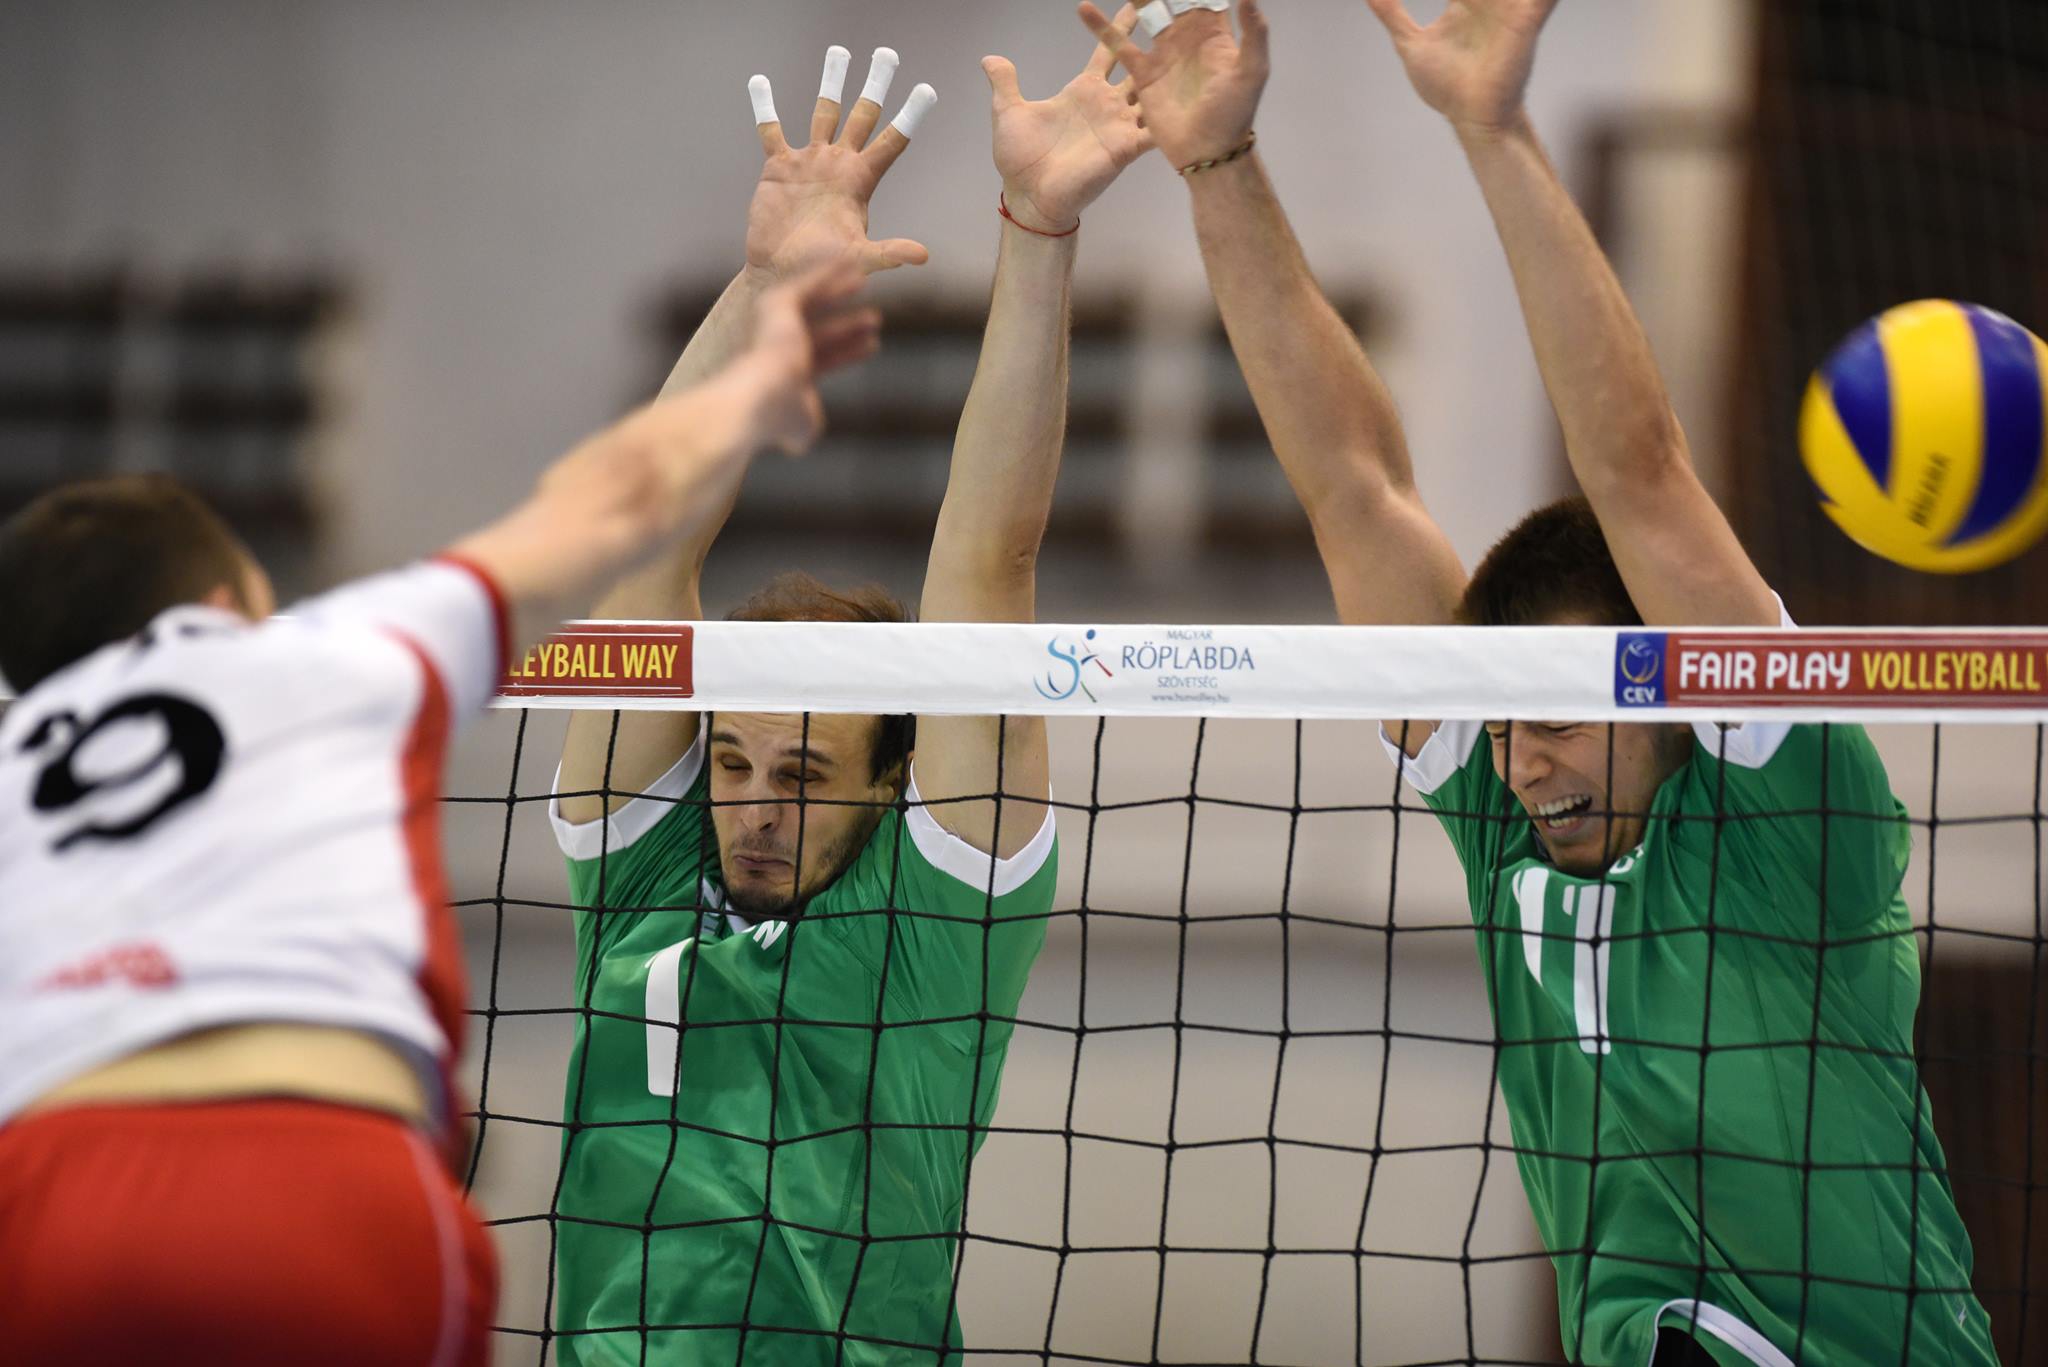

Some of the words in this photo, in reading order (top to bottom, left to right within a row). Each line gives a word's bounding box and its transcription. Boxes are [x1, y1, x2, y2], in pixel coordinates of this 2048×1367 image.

[1166, 630, 1213, 640] MAGYAR
[621, 644, 678, 679] WAY
[1121, 641, 1256, 670] RÖPLABDA
[1679, 651, 1756, 689] FAIR
[1765, 651, 1851, 690] PLAY
[1862, 651, 2042, 691] VOLLEYBALL
[1622, 686, 1656, 704] CEV
